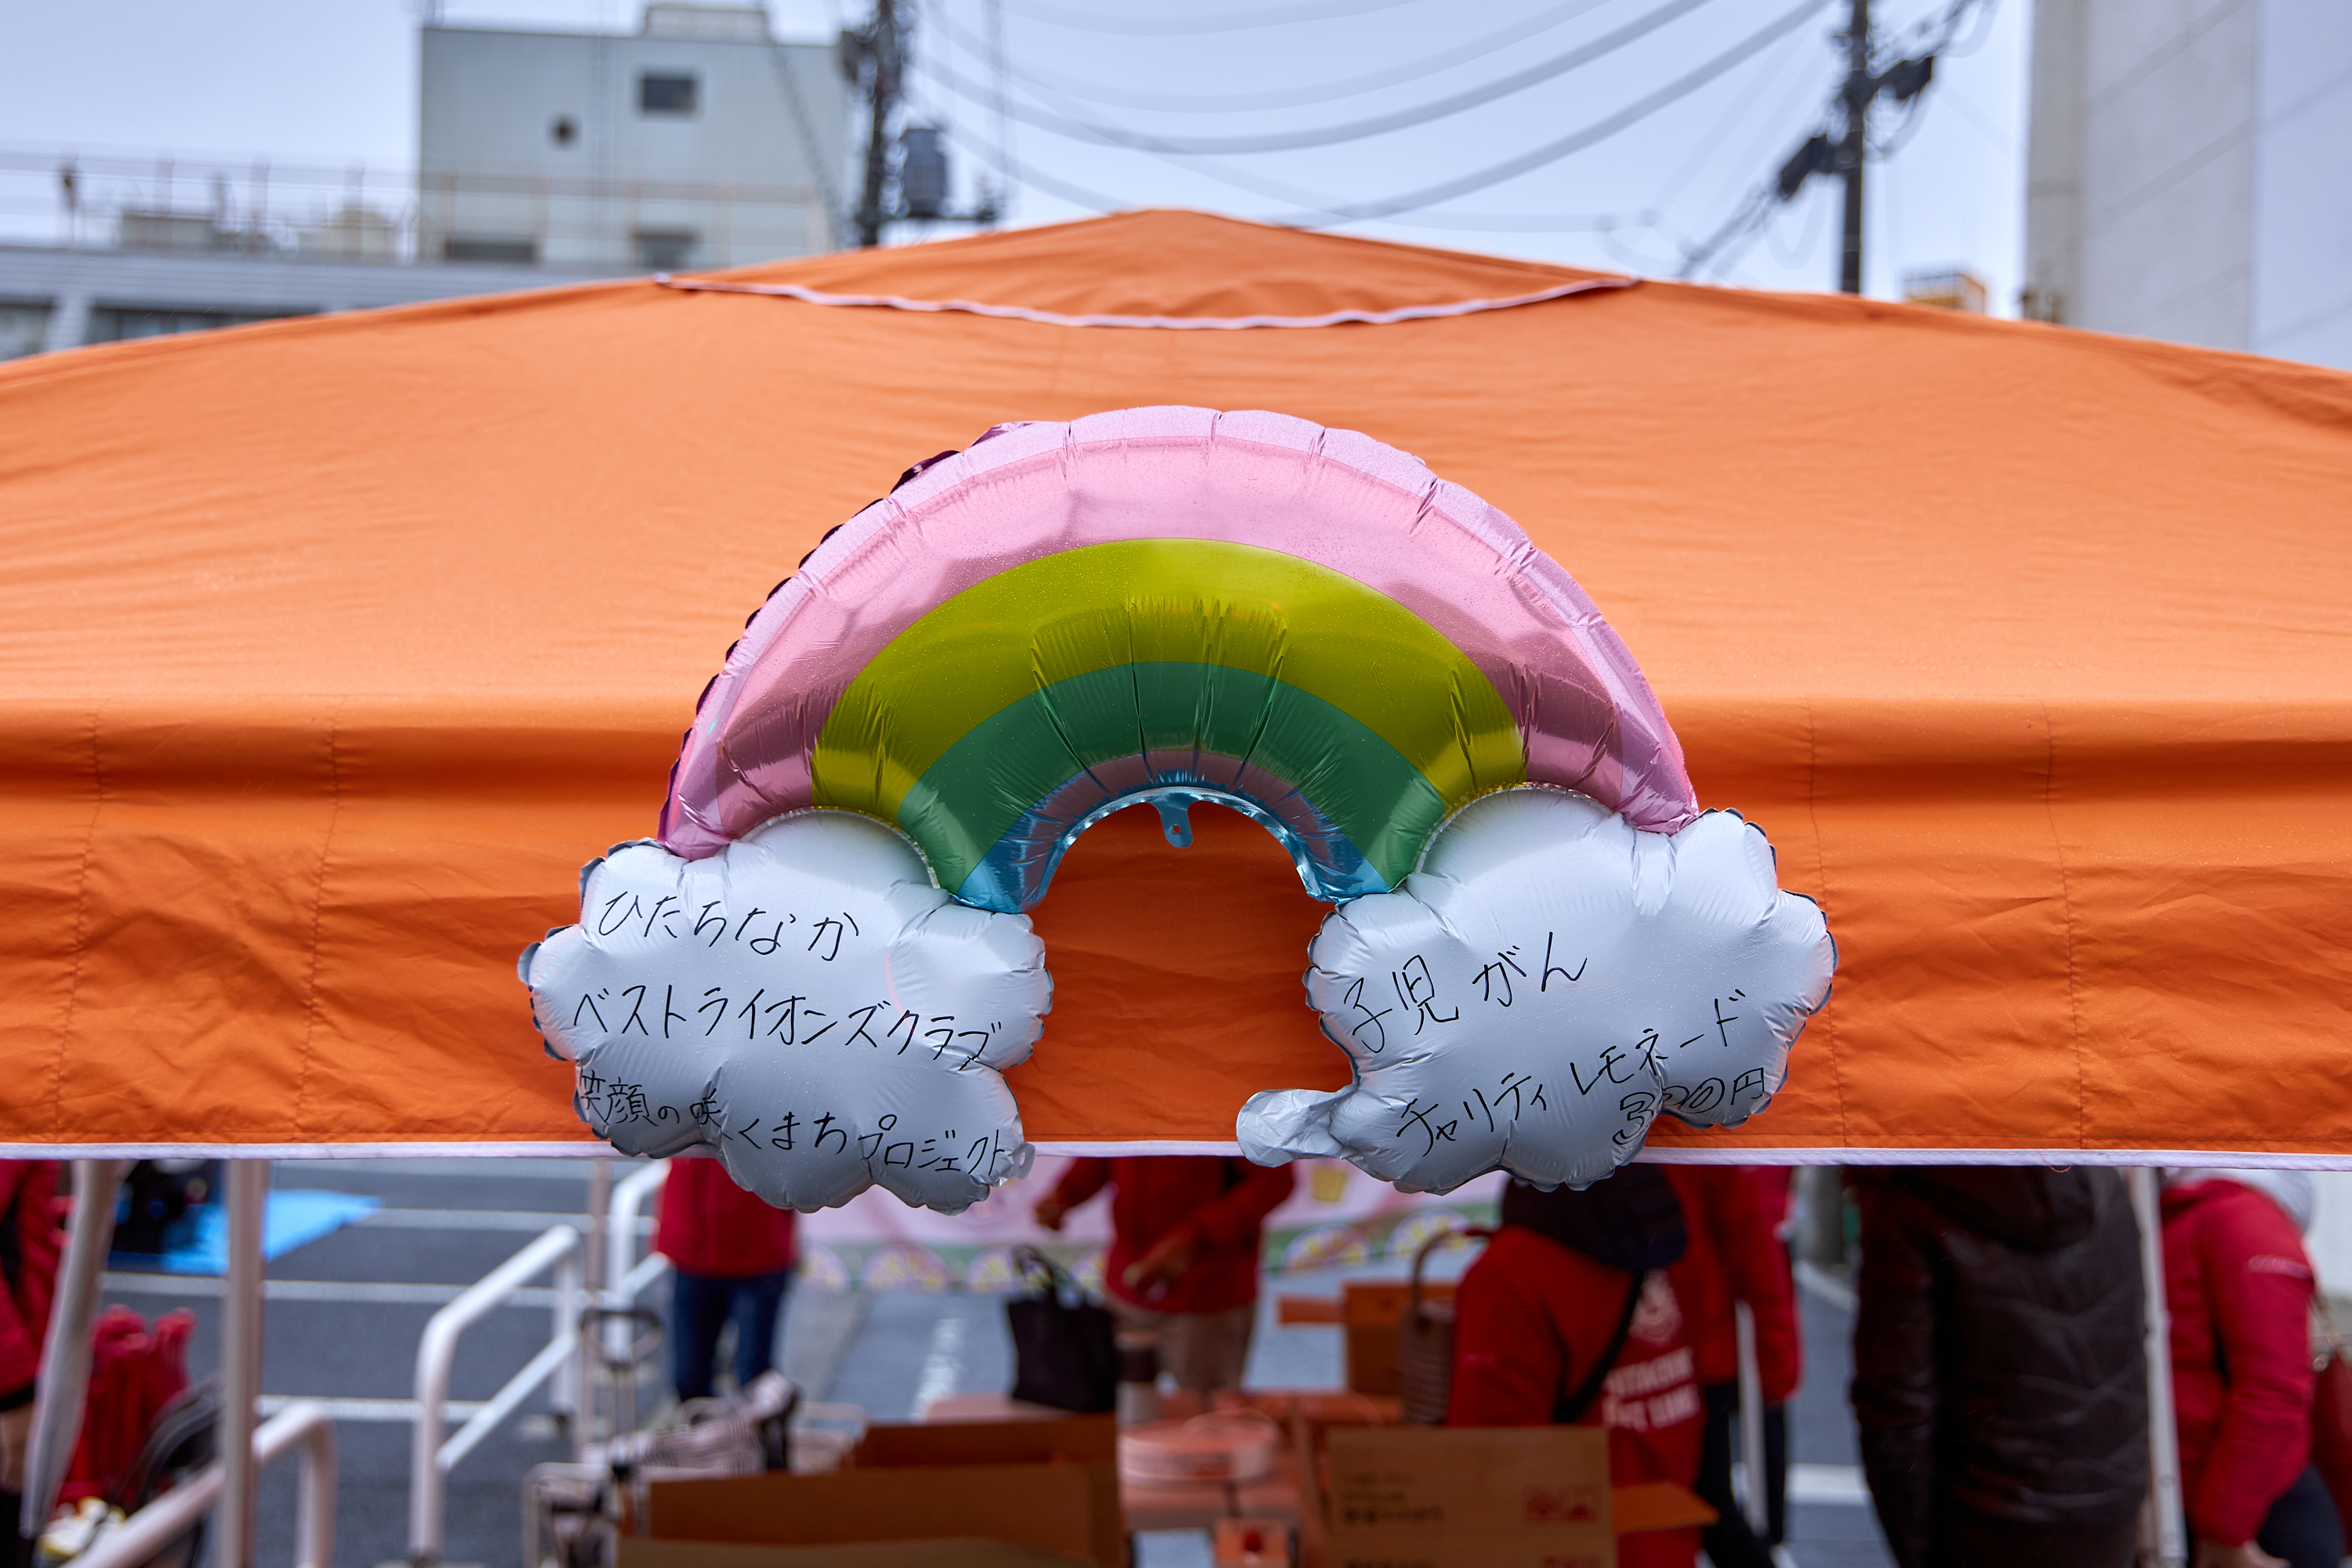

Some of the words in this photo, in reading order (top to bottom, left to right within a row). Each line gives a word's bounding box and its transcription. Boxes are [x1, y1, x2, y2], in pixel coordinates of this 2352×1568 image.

[598, 891, 859, 961] ひたちなか
[574, 984, 1002, 1071] ベストライオンズクラブ
[580, 1069, 1006, 1176] 笑顔の咲くまちプロジェクト
